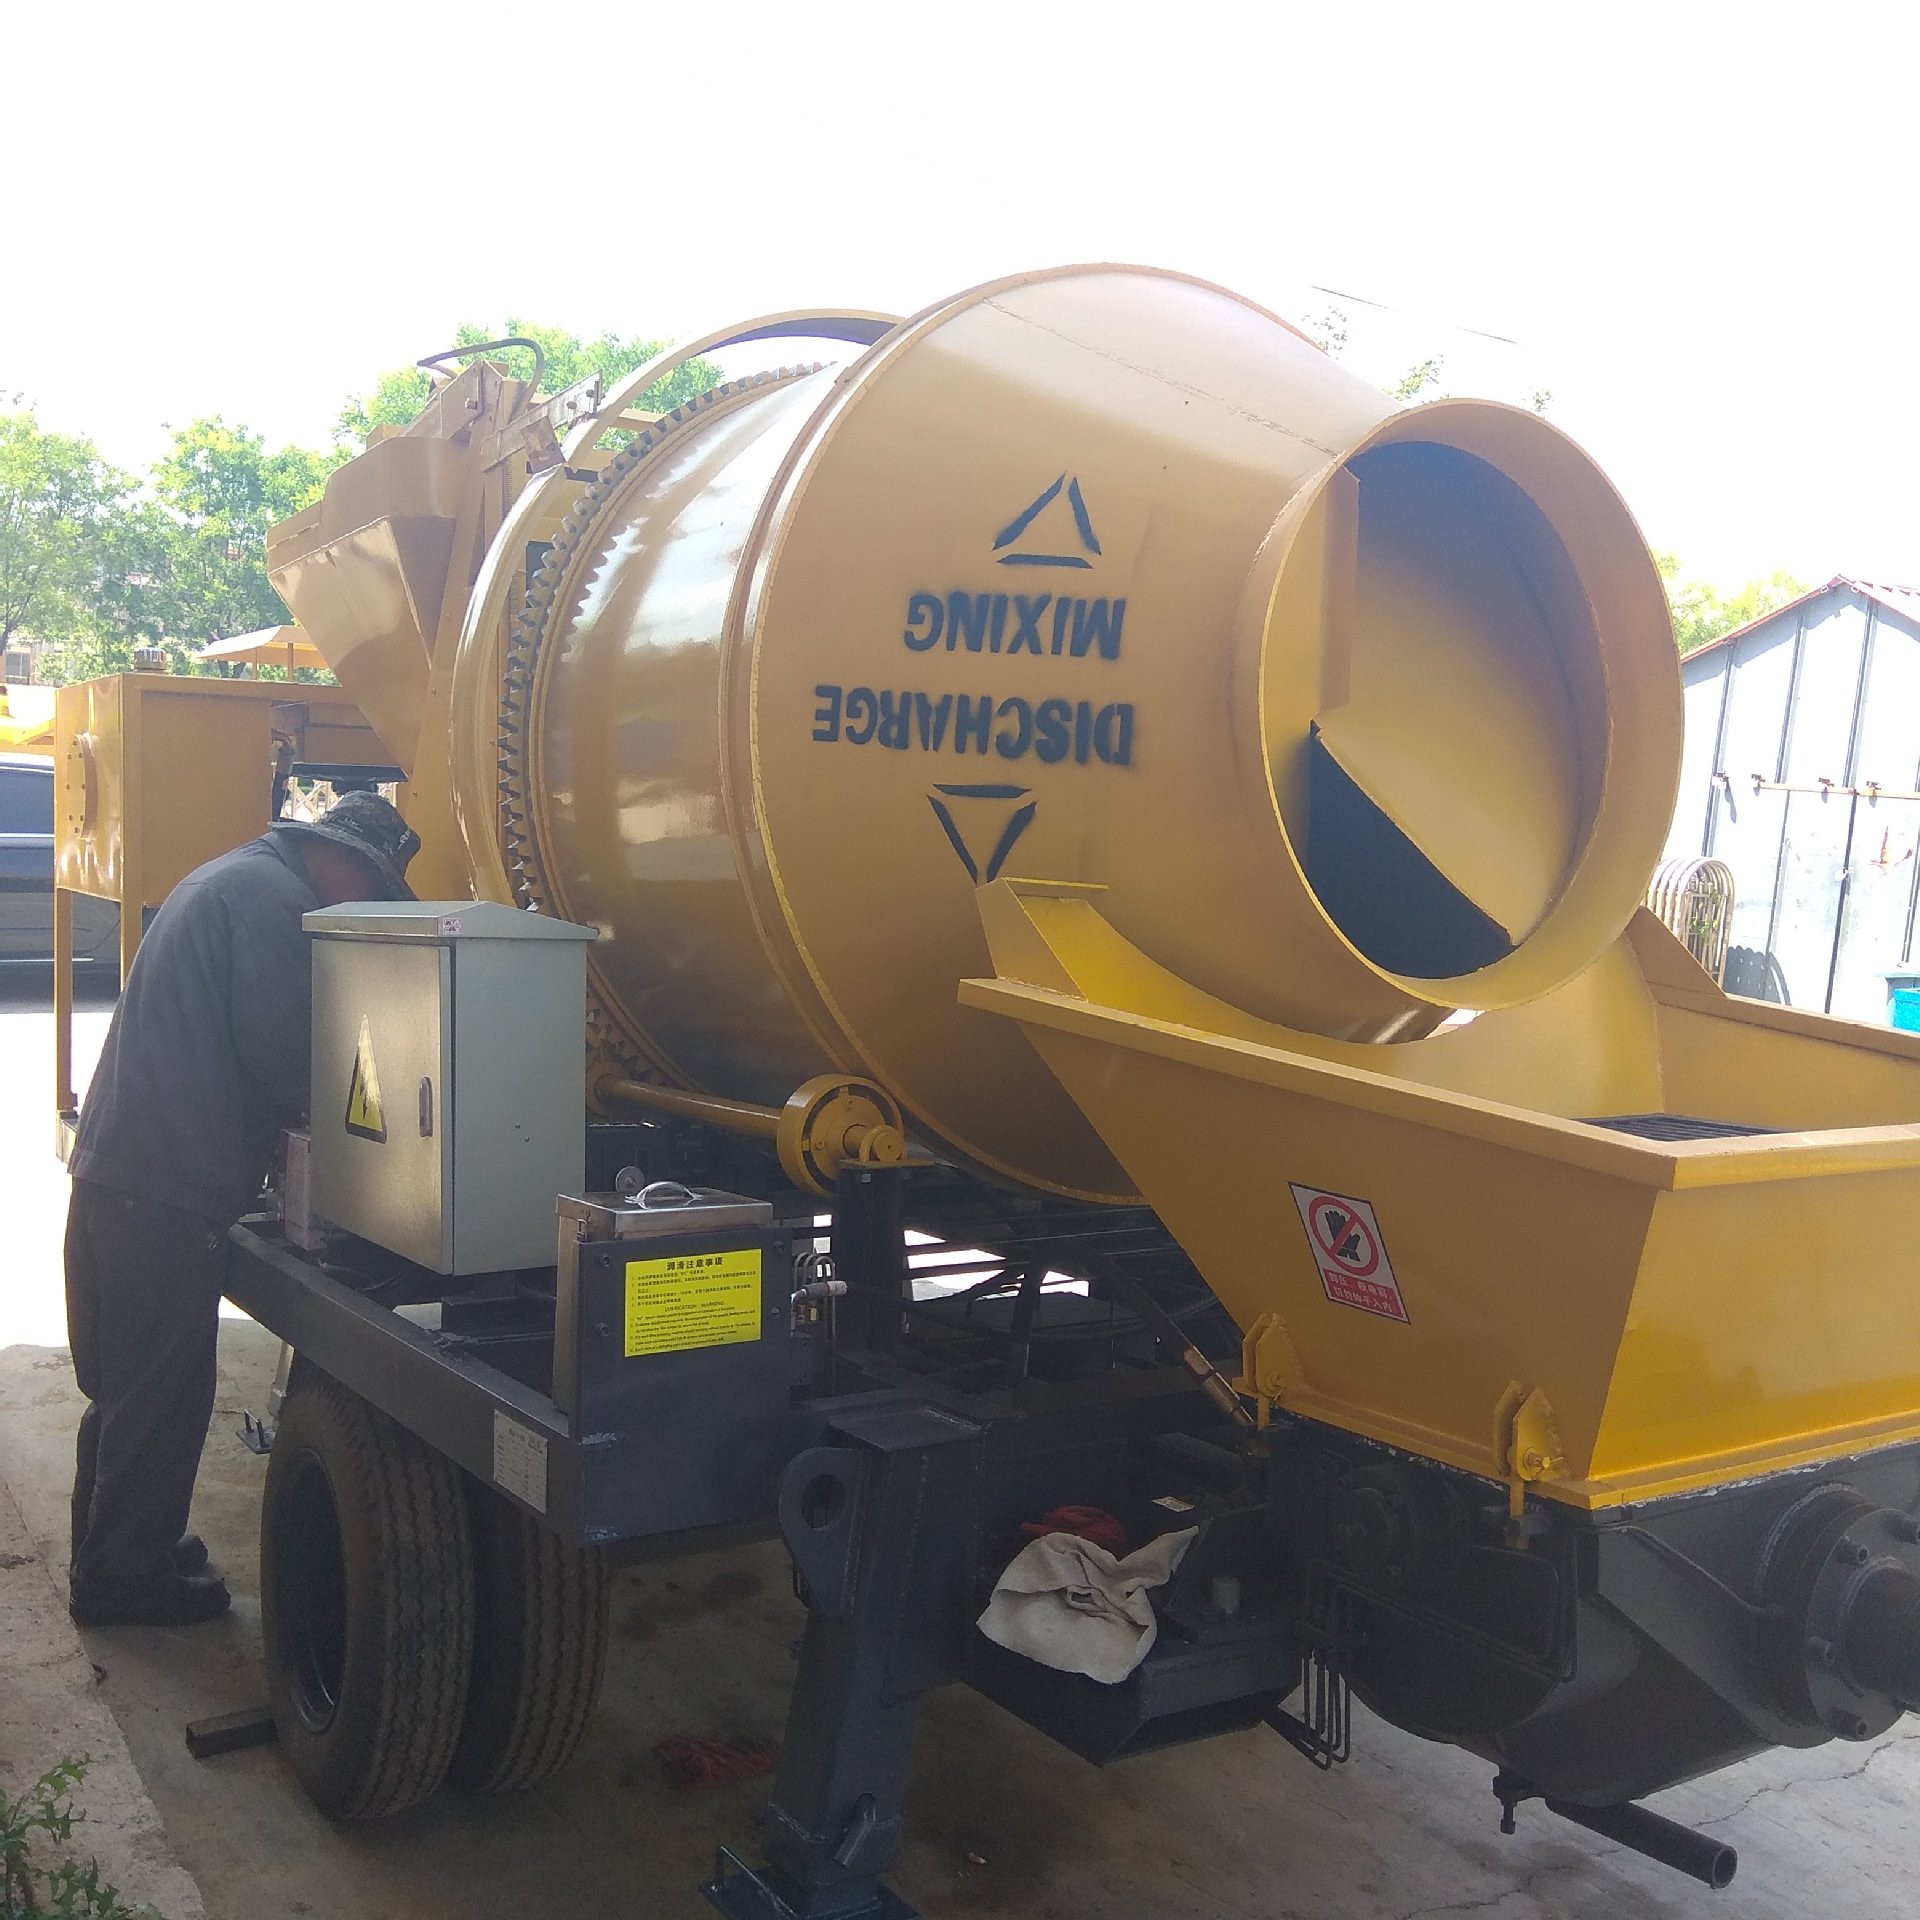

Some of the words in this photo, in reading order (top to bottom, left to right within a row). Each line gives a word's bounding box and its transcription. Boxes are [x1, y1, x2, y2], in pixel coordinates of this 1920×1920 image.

[904, 591, 1126, 660] MIXING
[813, 685, 1134, 766] DISCHARGE
[666, 1257, 723, 1271] 润滑注意事项
